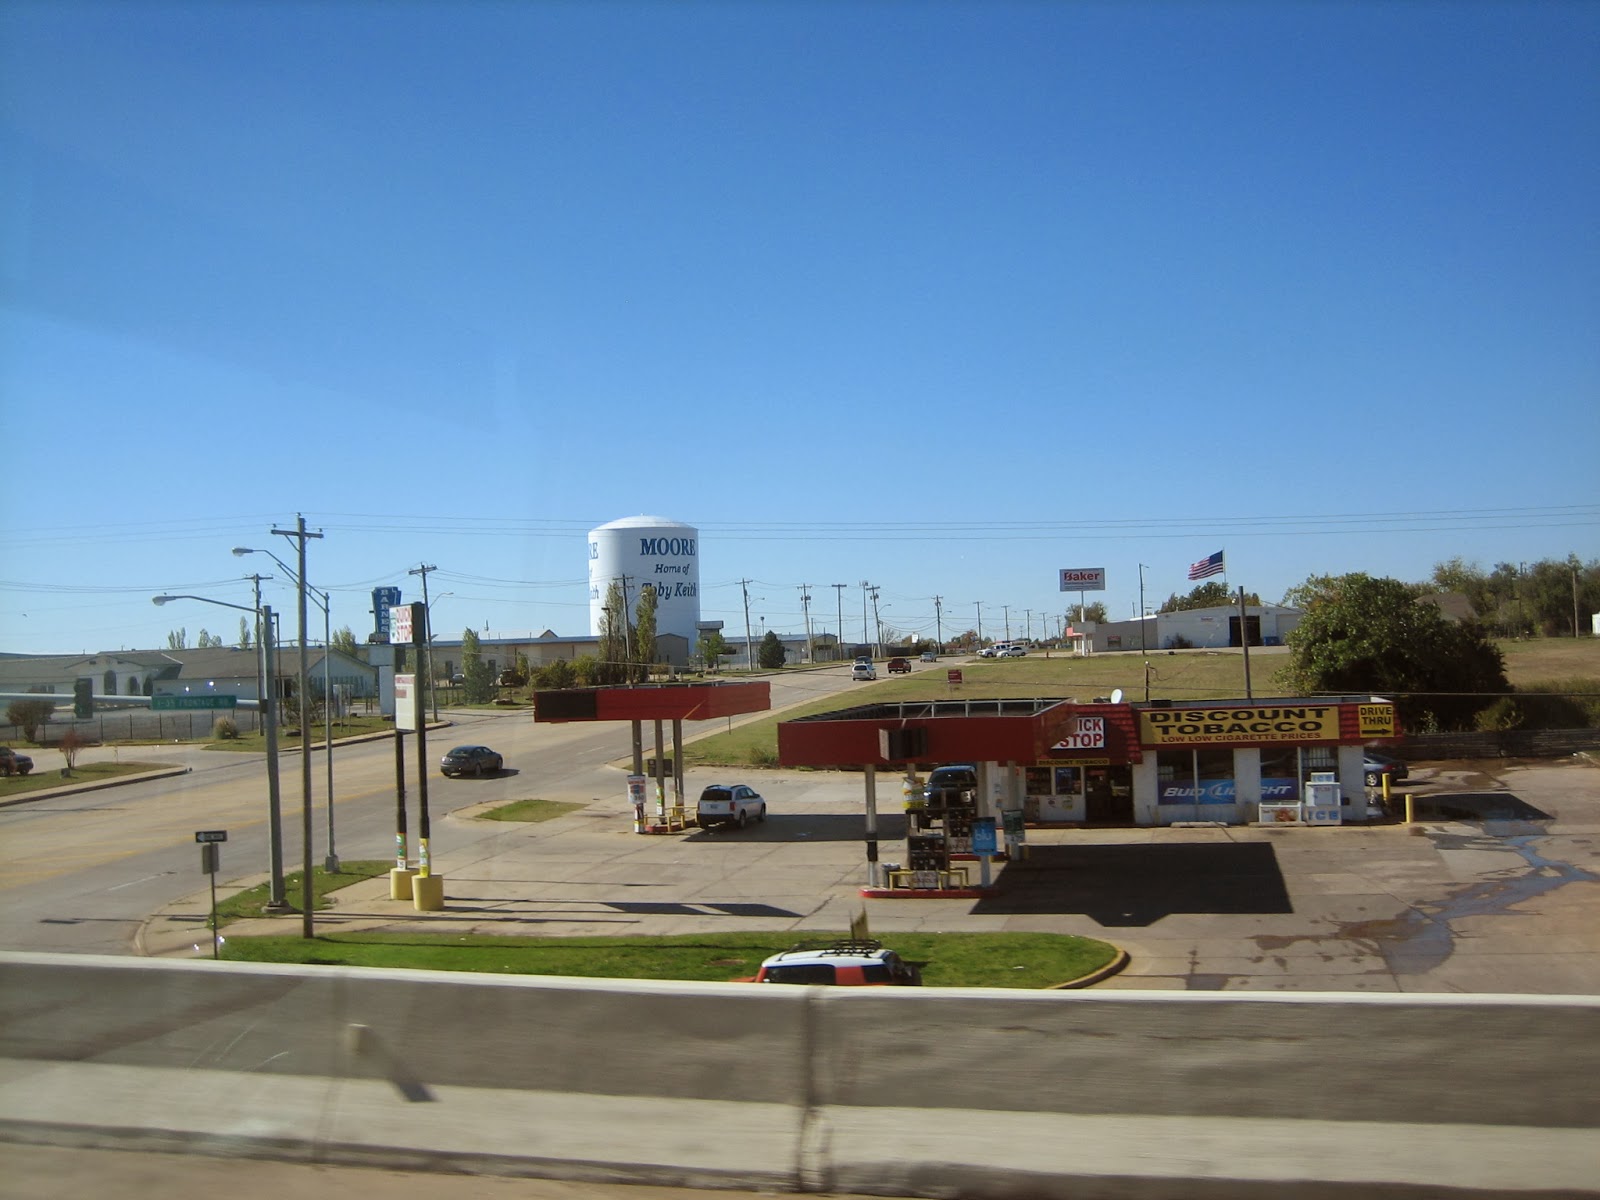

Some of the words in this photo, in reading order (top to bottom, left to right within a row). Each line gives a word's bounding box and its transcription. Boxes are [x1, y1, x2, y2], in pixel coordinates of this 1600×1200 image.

[640, 537, 696, 556] MOORE
[654, 563, 681, 574] Home
[682, 563, 691, 576] of
[1063, 571, 1100, 582] Baker
[674, 582, 697, 598] Keith
[380, 589, 390, 633] BARNES
[396, 625, 413, 642] STOP
[1149, 707, 1330, 723] DISCOUNT
[1360, 706, 1393, 716] DRIVE
[1079, 718, 1103, 732] ICK
[1362, 716, 1392, 725] THRU
[1155, 721, 1323, 735] TOBACCO
[1059, 733, 1104, 748] STOP
[1215, 733, 1277, 741] CIGARETTE
[1281, 732, 1321, 740] PRICES
[1163, 787, 1206, 797] BUD
[1308, 810, 1340, 821] ICE
[974, 828, 993, 842] blu
